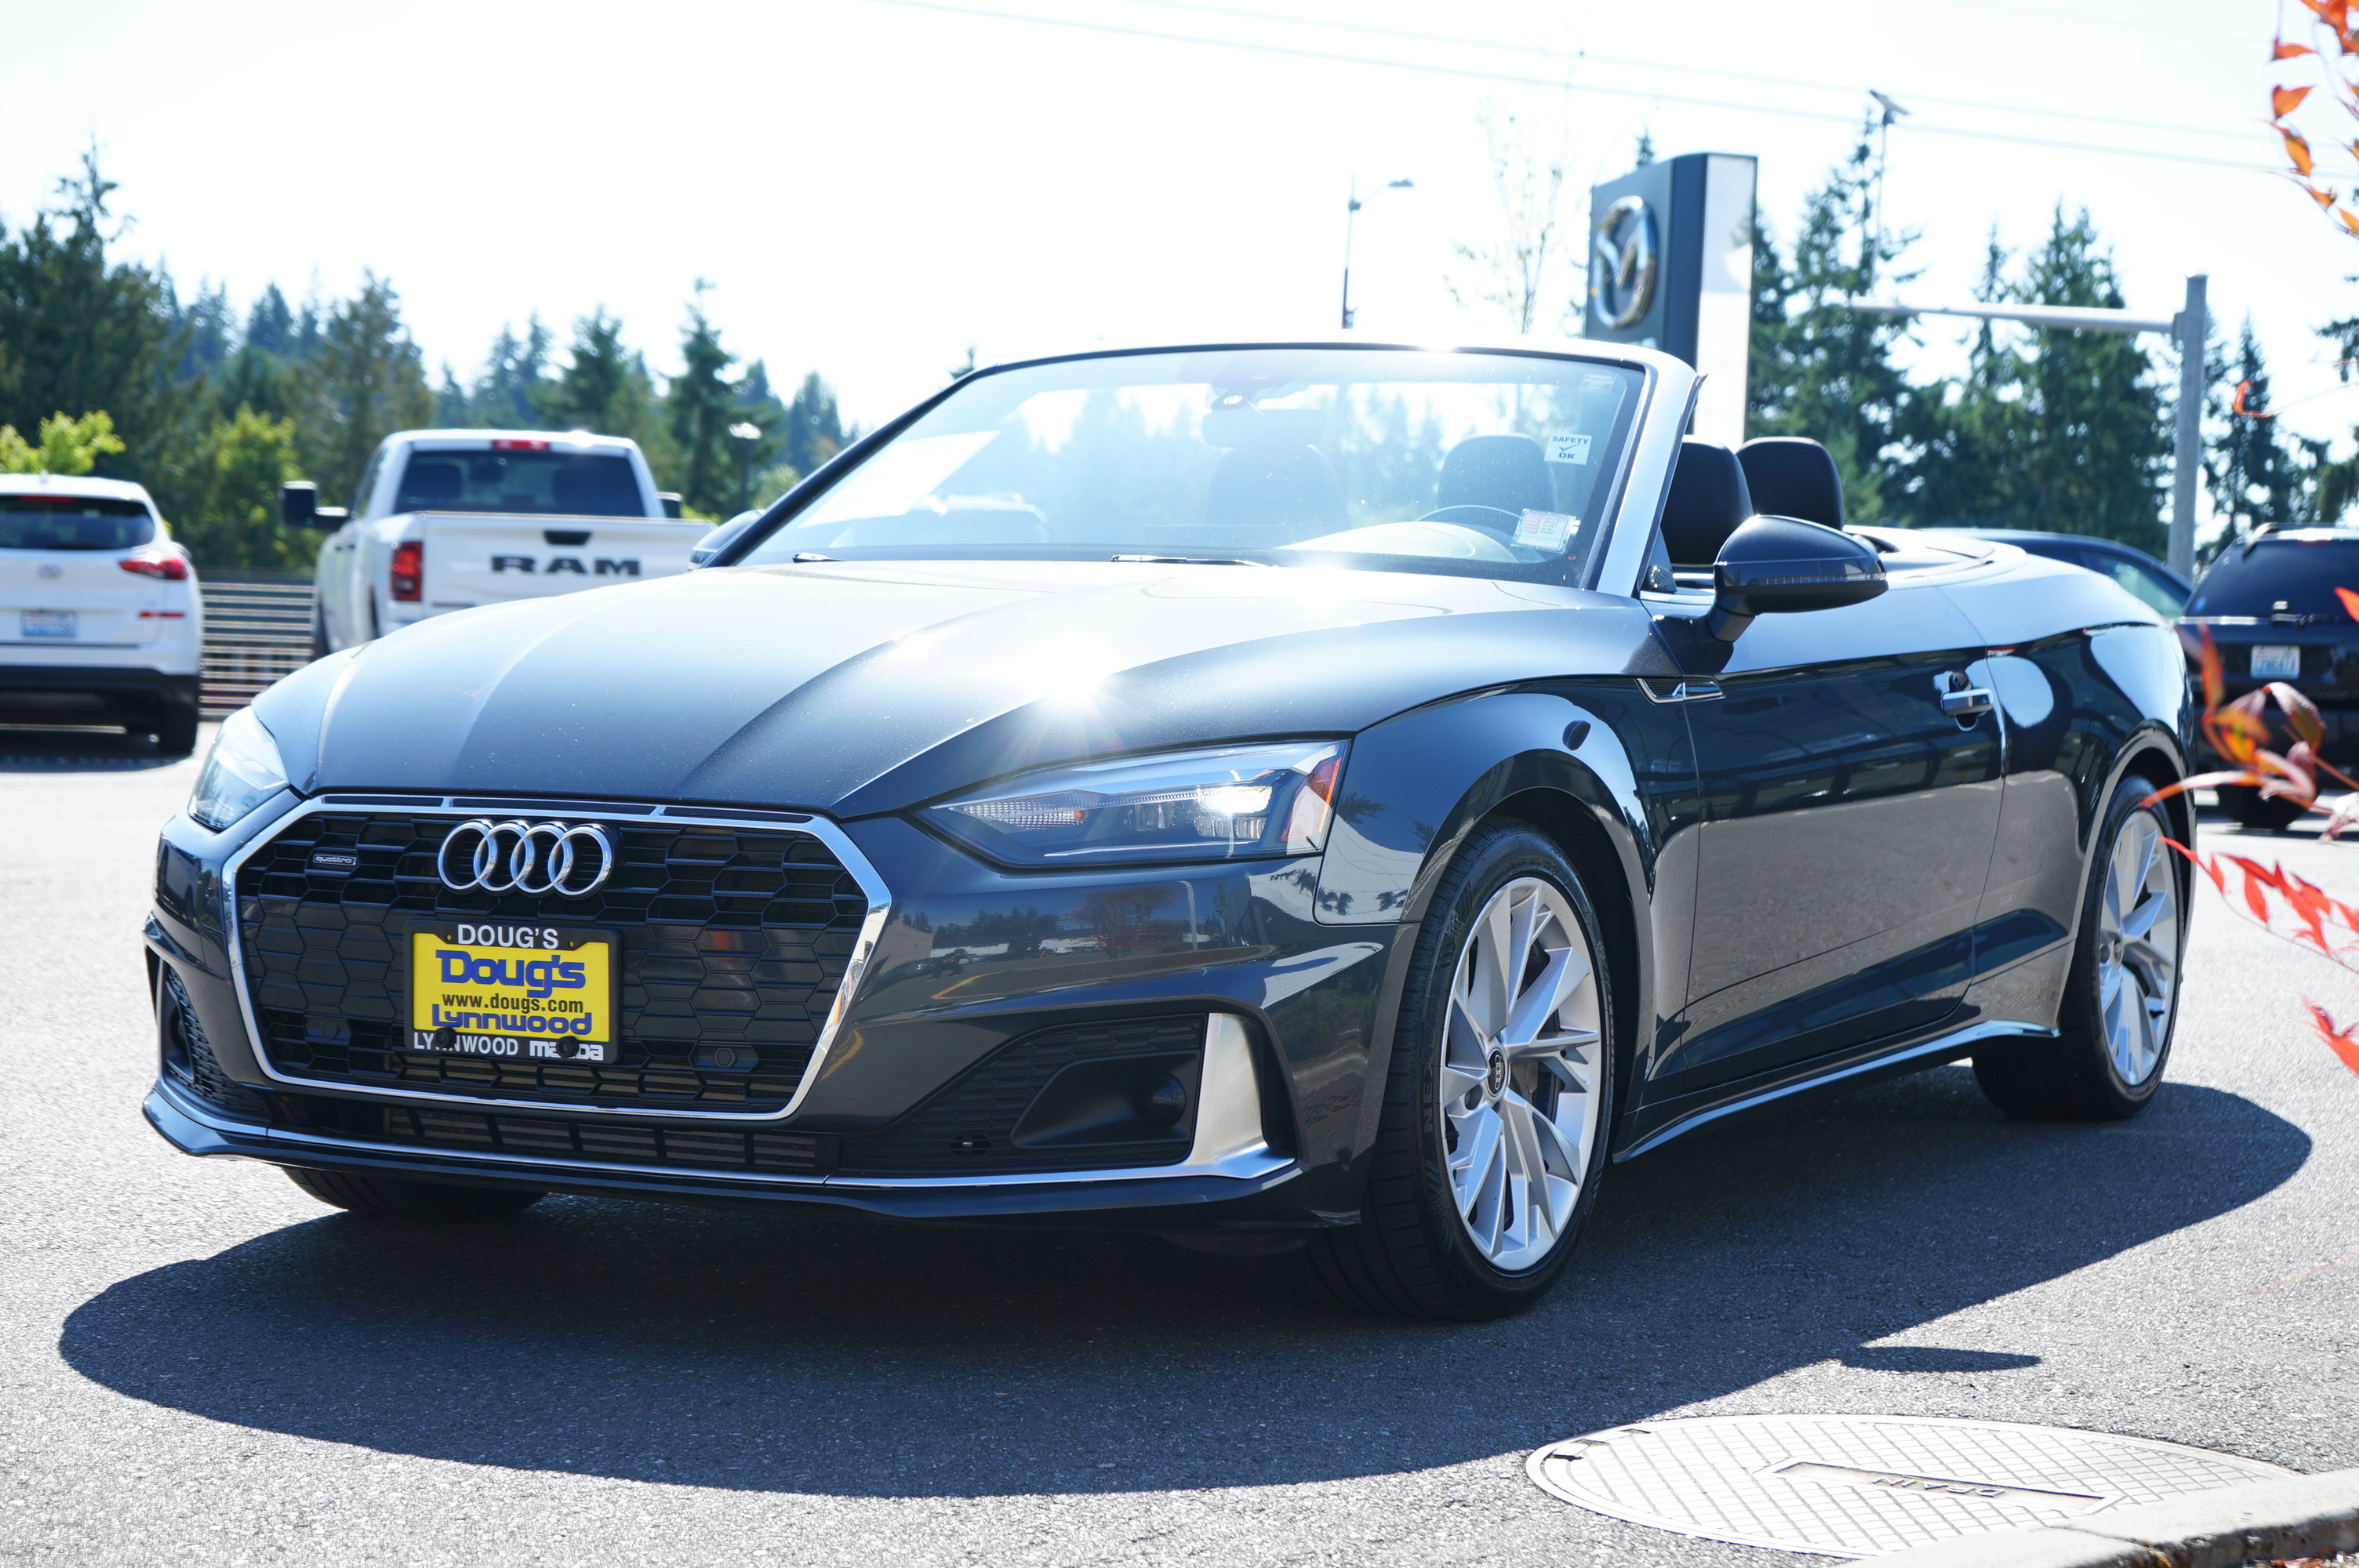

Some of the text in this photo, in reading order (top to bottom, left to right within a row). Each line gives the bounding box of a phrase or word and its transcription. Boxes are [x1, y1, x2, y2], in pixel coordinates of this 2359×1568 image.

[1552, 435, 1589, 445] SAFETY
[490, 555, 641, 576] RAM
[457, 924, 558, 949] DOUG'S
[435, 949, 587, 998] Doug's
[442, 993, 583, 1014] www.dougs.com
[431, 1004, 592, 1035] Lynnwood
[413, 1032, 604, 1062] LYNWOOD mada
